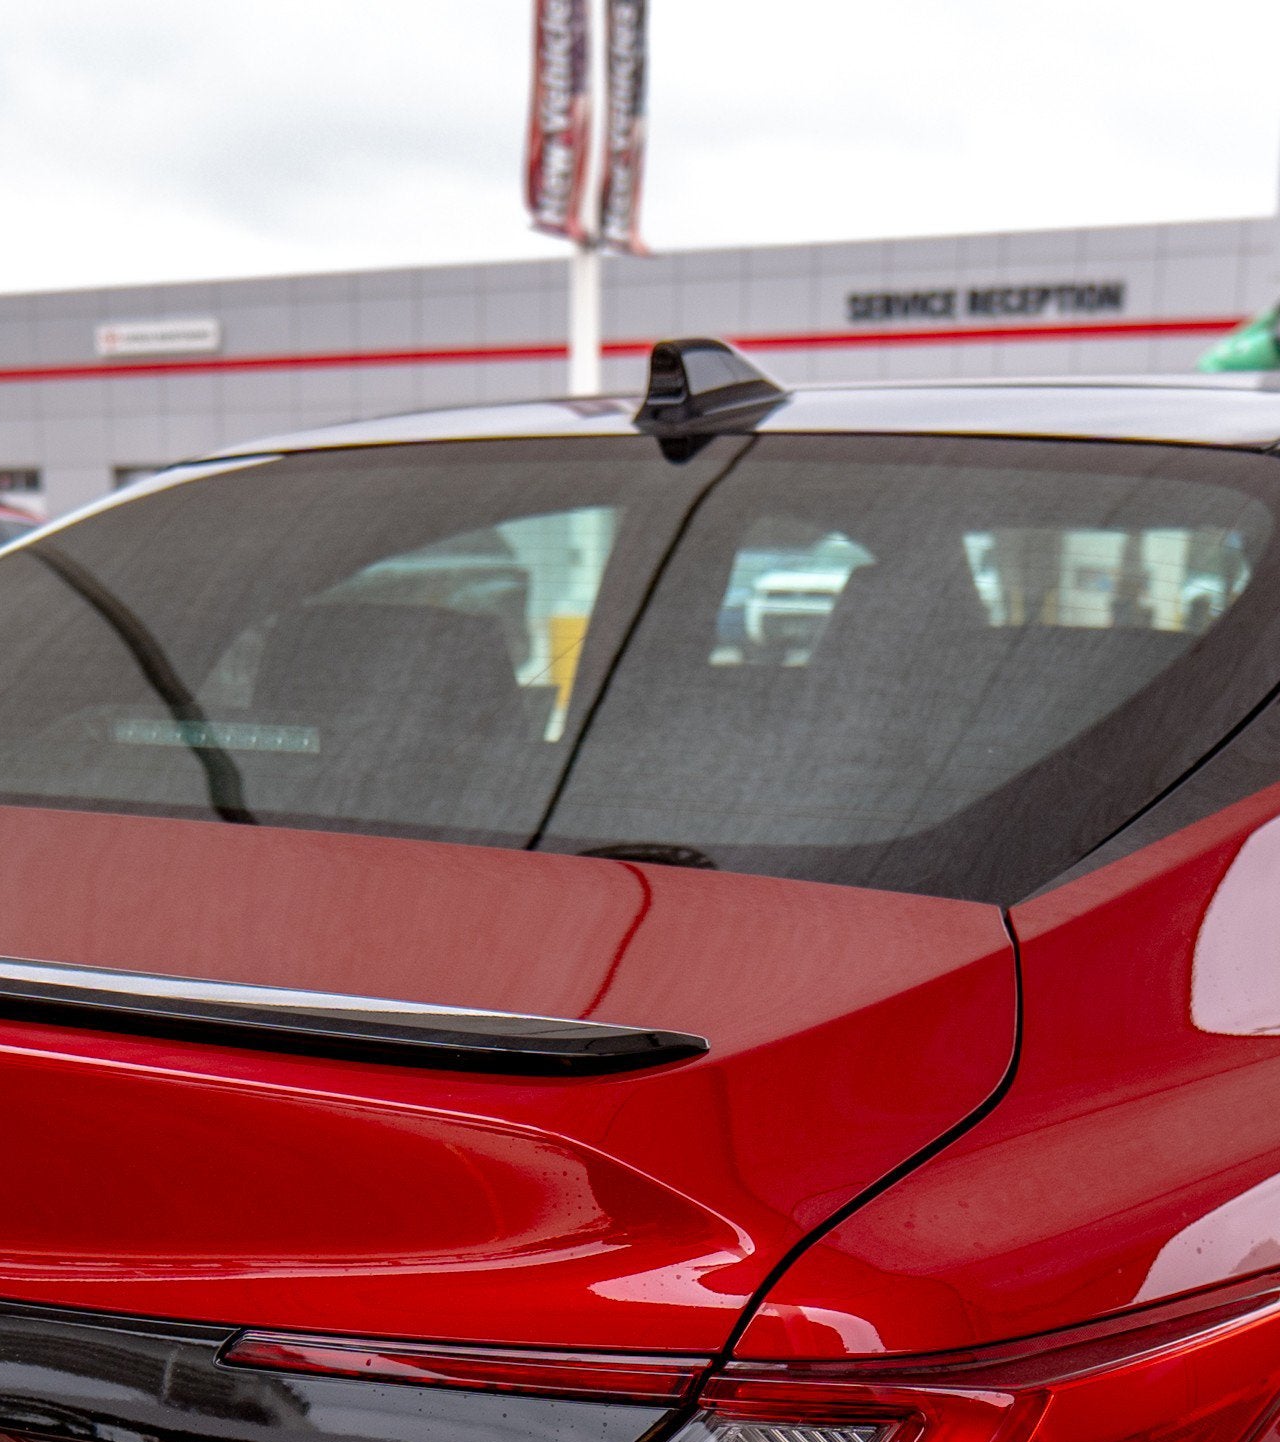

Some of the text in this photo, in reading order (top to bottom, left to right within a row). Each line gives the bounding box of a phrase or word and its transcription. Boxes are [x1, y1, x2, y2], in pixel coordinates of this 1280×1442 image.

[535, 142, 571, 225] New
[848, 281, 1127, 322] SERVICE RECEPTION
